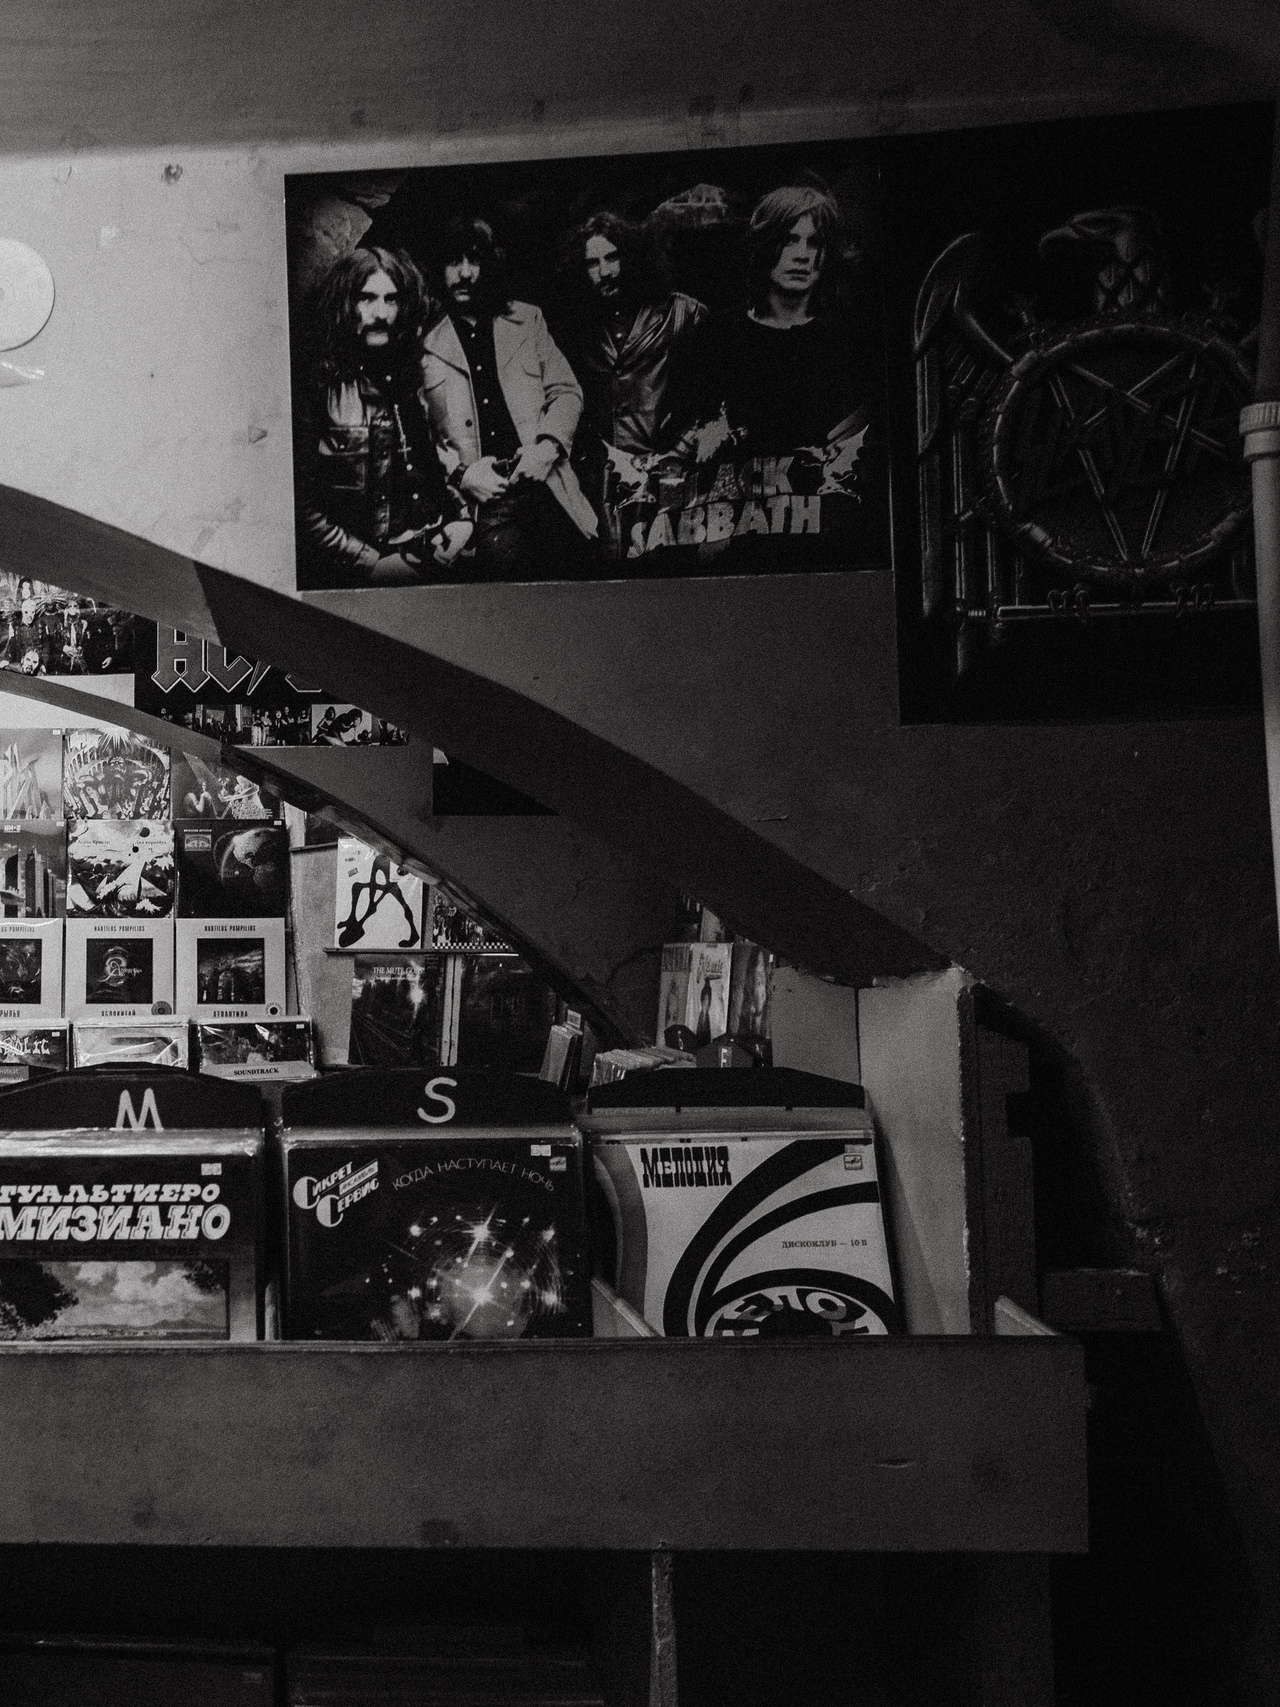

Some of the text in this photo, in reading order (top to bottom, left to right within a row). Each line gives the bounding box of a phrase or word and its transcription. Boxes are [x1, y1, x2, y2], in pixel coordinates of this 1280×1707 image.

[626, 494, 822, 560] SABBATH
[233, 1067, 279, 1076] SOUNDTRACK
[115, 1087, 164, 1132] M
[417, 1077, 458, 1124] S
[392, 1165, 434, 1191] КОГДА
[437, 1157, 518, 1175] НАСТУПАЕТ
[521, 1167, 555, 1192] НОЧЬ
[781, 1239, 837, 1249] ДИСКОКЛУБ
